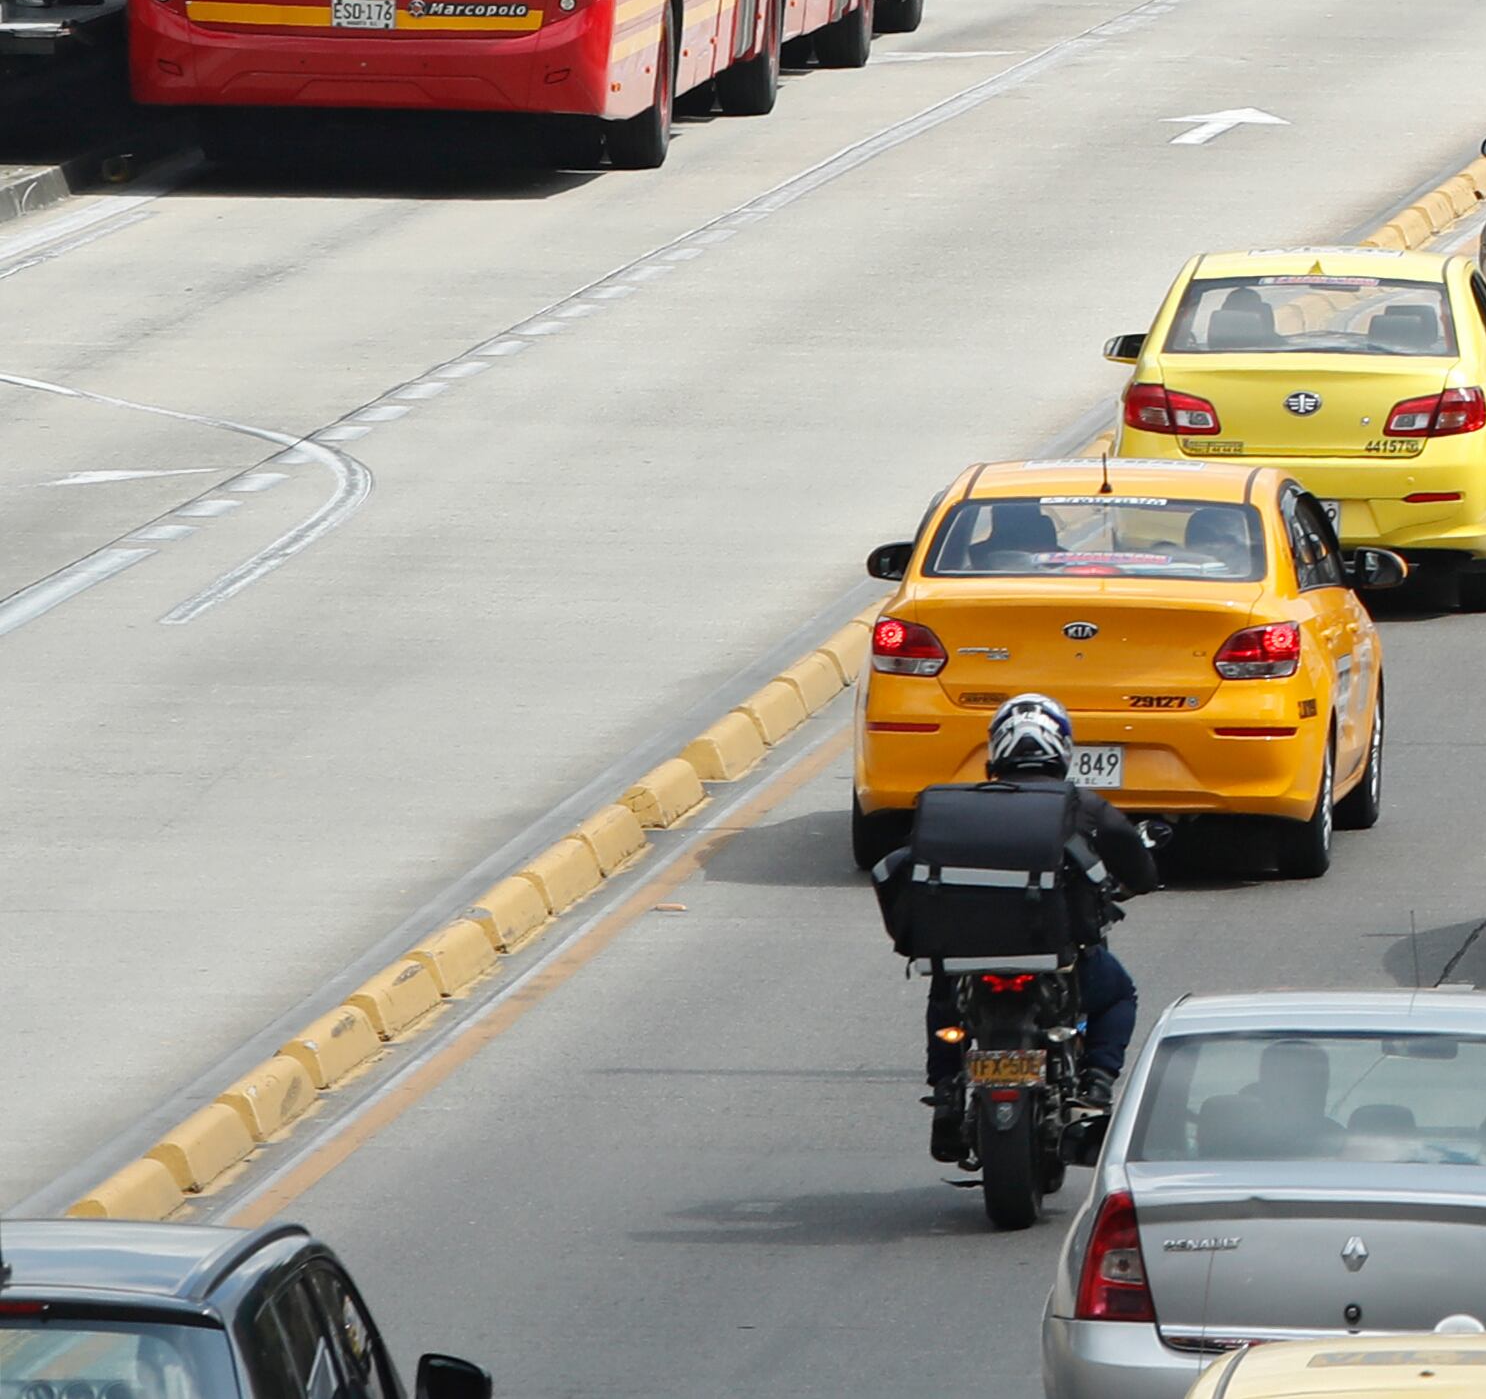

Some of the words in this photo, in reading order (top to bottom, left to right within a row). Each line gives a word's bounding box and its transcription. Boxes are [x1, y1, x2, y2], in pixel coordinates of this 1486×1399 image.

[429, 2, 527, 17] Marcopolo
[1066, 624, 1096, 639] KIA
[1130, 695, 1187, 708] 29127
[1163, 1236, 1242, 1252] RENAULT
